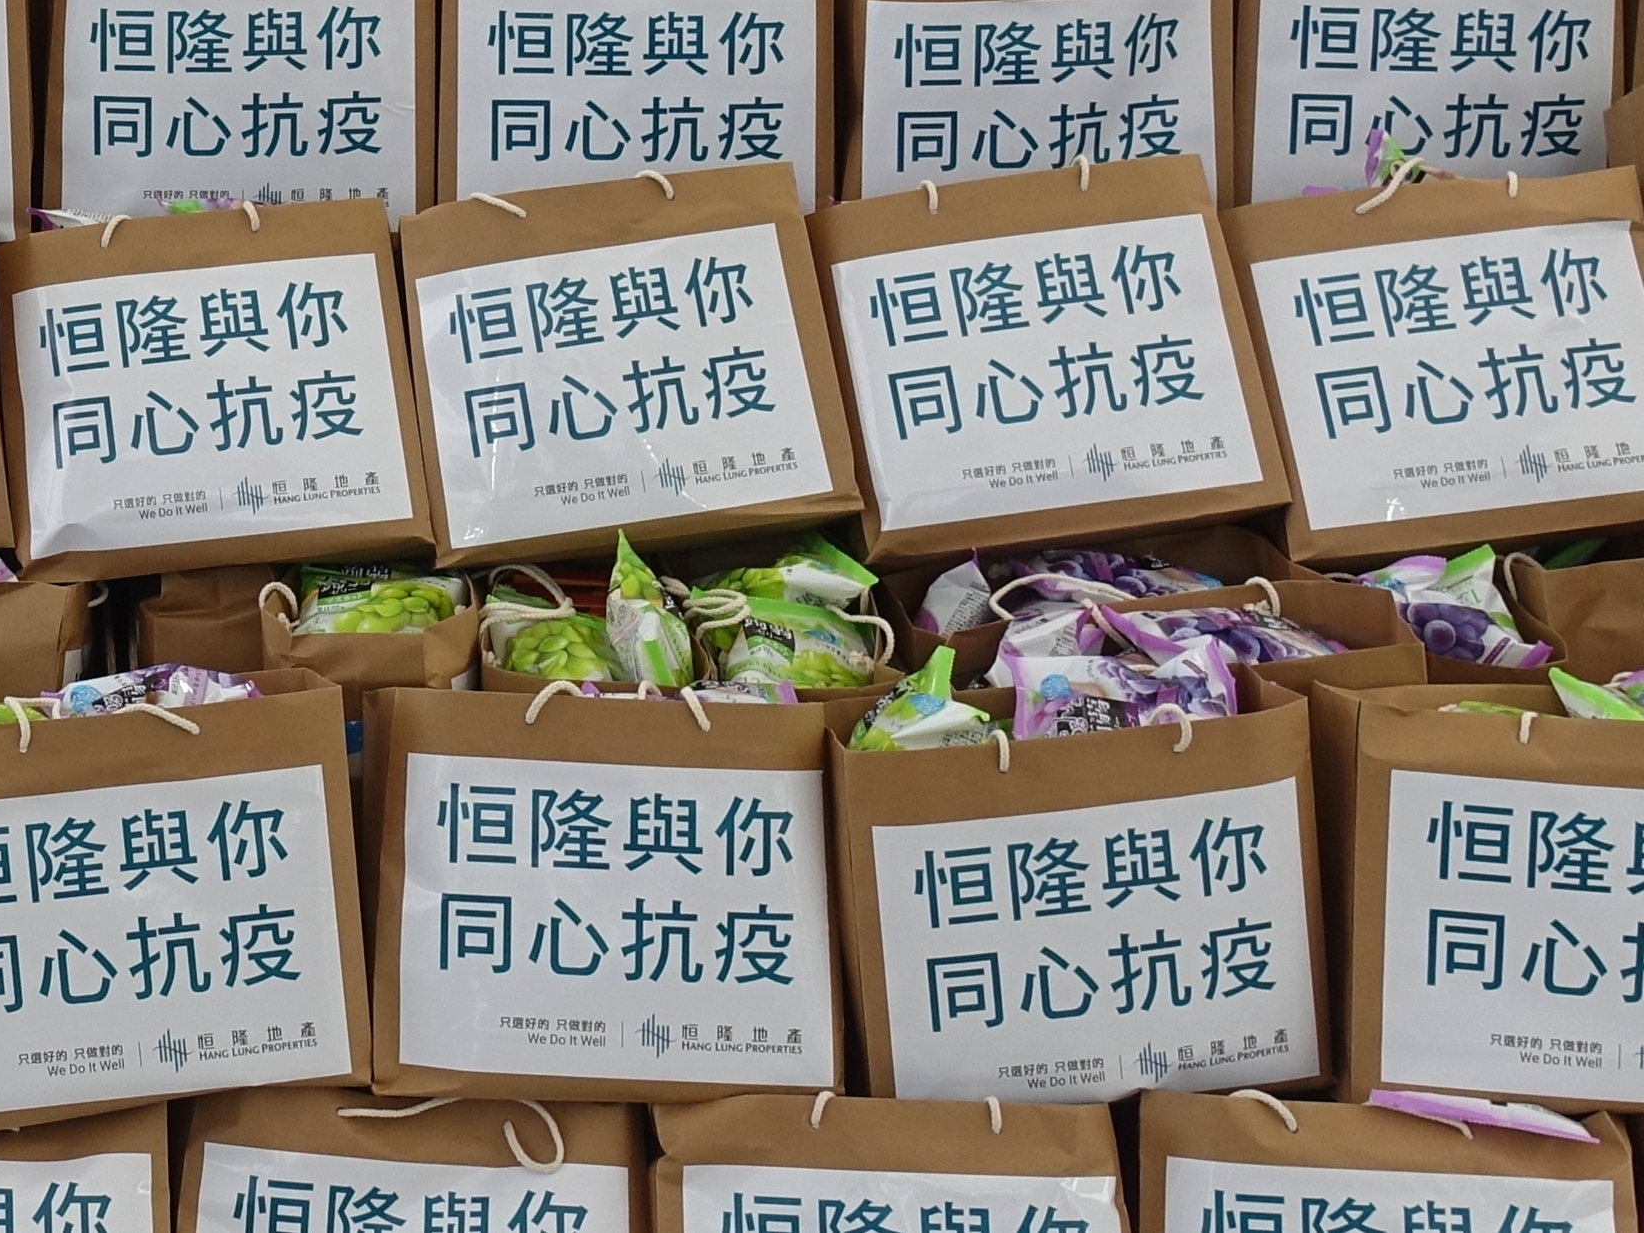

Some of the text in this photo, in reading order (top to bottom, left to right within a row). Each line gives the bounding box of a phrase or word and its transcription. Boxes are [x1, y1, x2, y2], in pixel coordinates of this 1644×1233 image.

[93, 6, 381, 73] 恒隆與你
[488, 10, 785, 76] 恒隆與你
[894, 13, 1178, 88] 恒隆與你
[1292, 5, 1592, 73] 恒隆與你
[94, 91, 381, 158] 同心抗疫
[491, 97, 783, 162] 同心抗疫
[897, 94, 1183, 174] 同心抗疫
[1289, 93, 1583, 158] 同心抗疫
[447, 257, 753, 363] 恒隆與你
[870, 245, 1181, 346] 恒隆與你
[1292, 249, 1607, 346] 恒隆與你
[40, 282, 347, 377] 恒隆與你
[53, 370, 363, 468] 同心抗疫
[465, 346, 775, 457] 同心抗疫
[888, 335, 1203, 439] 同心抗疫
[1315, 338, 1636, 439] 同心抗疫
[989, 471, 1059, 488] We Do It Well
[1121, 434, 1224, 463] 恒隆地產
[1124, 450, 1227, 471] HANG LUNG PROPERTIES
[139, 503, 209, 519] We Do It Well
[273, 470, 379, 496] 恒隆地產
[274, 485, 381, 505] HANG LUNG PROPERTIES
[437, 783, 793, 876] 恒隆與你
[1430, 801, 1644, 895] 恒隆
[915, 818, 1267, 928] 恒隆與你
[440, 893, 793, 985] 同心抗疫
[1427, 909, 1644, 1003] 同心
[927, 918, 1276, 1032] 同心抗疫
[198, 1021, 316, 1051] 恒隆地產
[200, 1038, 318, 1062] HANG LUNG PROPERTIES
[527, 1033, 607, 1047] We Do It Well
[683, 1024, 801, 1044] 恒隆地產
[683, 1041, 802, 1054] HANG LUNG PROPERTIES
[47, 1059, 125, 1077] We Do It Well
